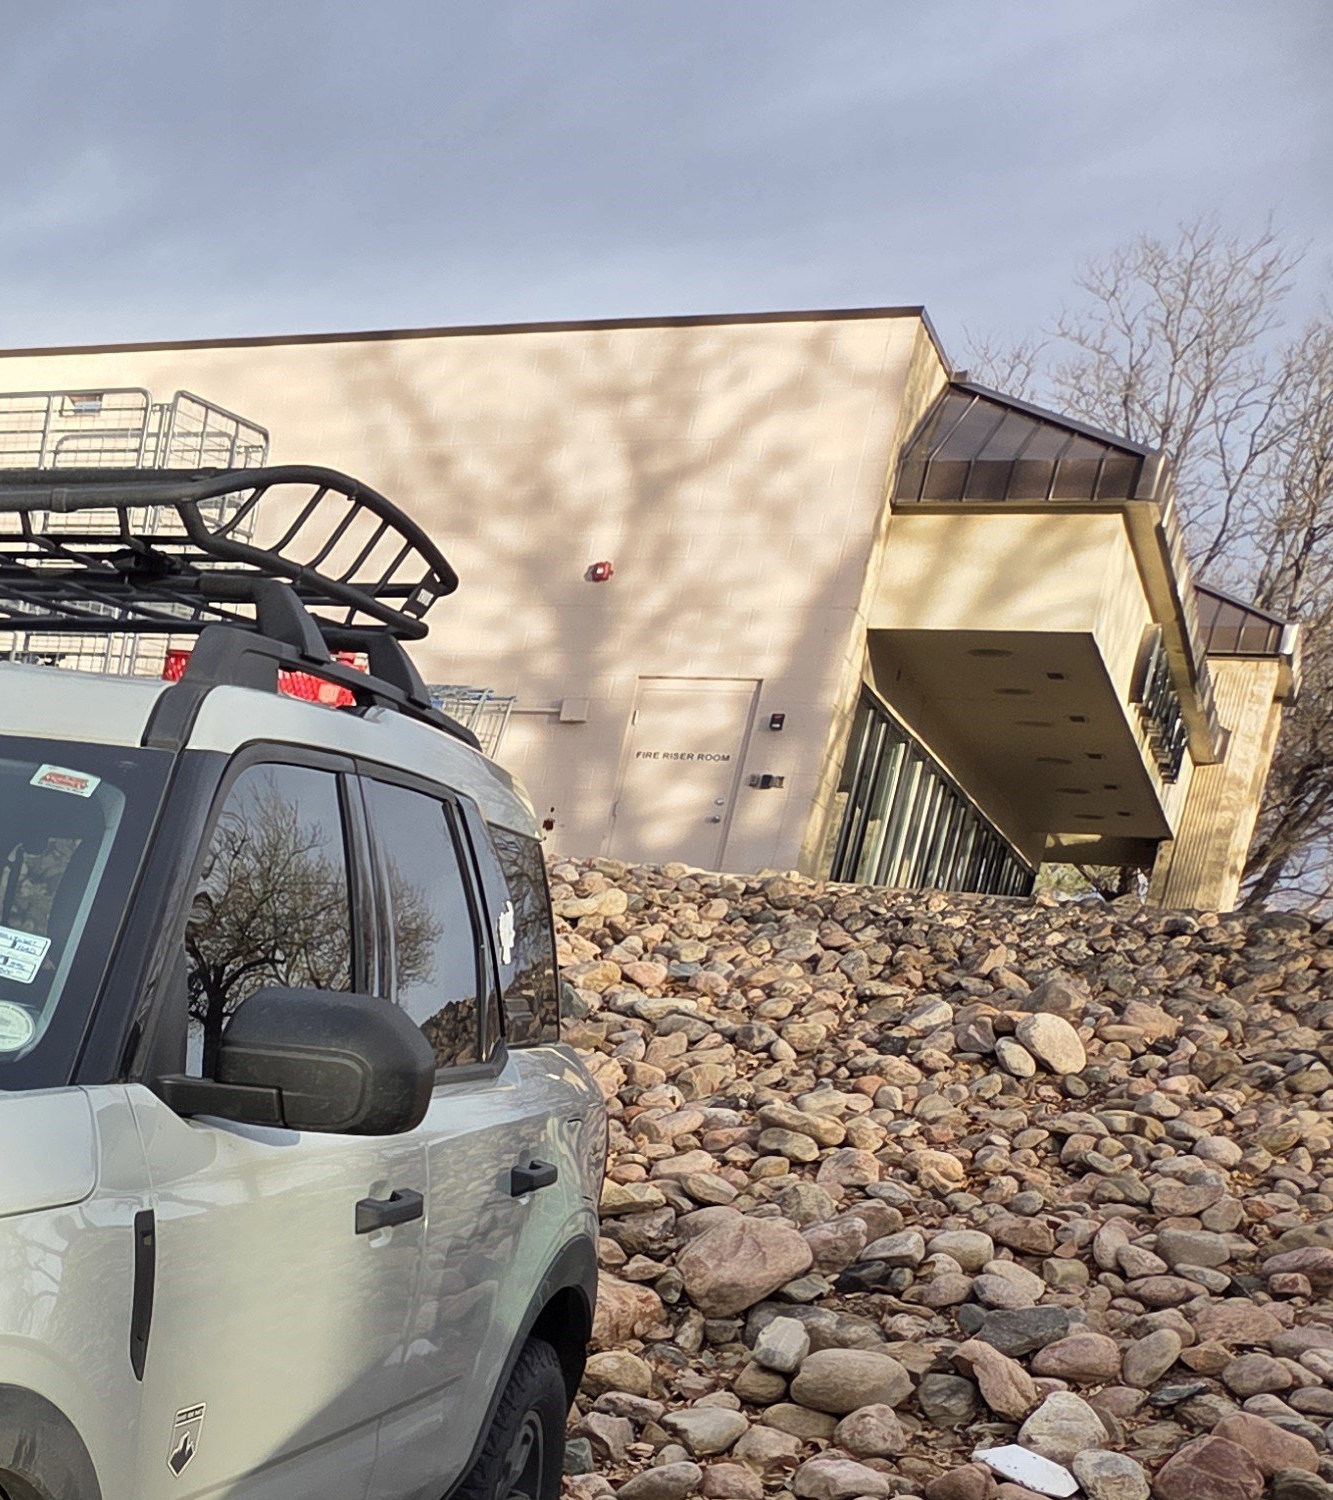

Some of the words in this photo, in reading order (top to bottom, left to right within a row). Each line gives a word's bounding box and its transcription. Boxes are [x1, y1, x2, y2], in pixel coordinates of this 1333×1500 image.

[635, 751, 660, 760] FIRE
[662, 752, 694, 761] RISER
[697, 753, 730, 762] ROOM
